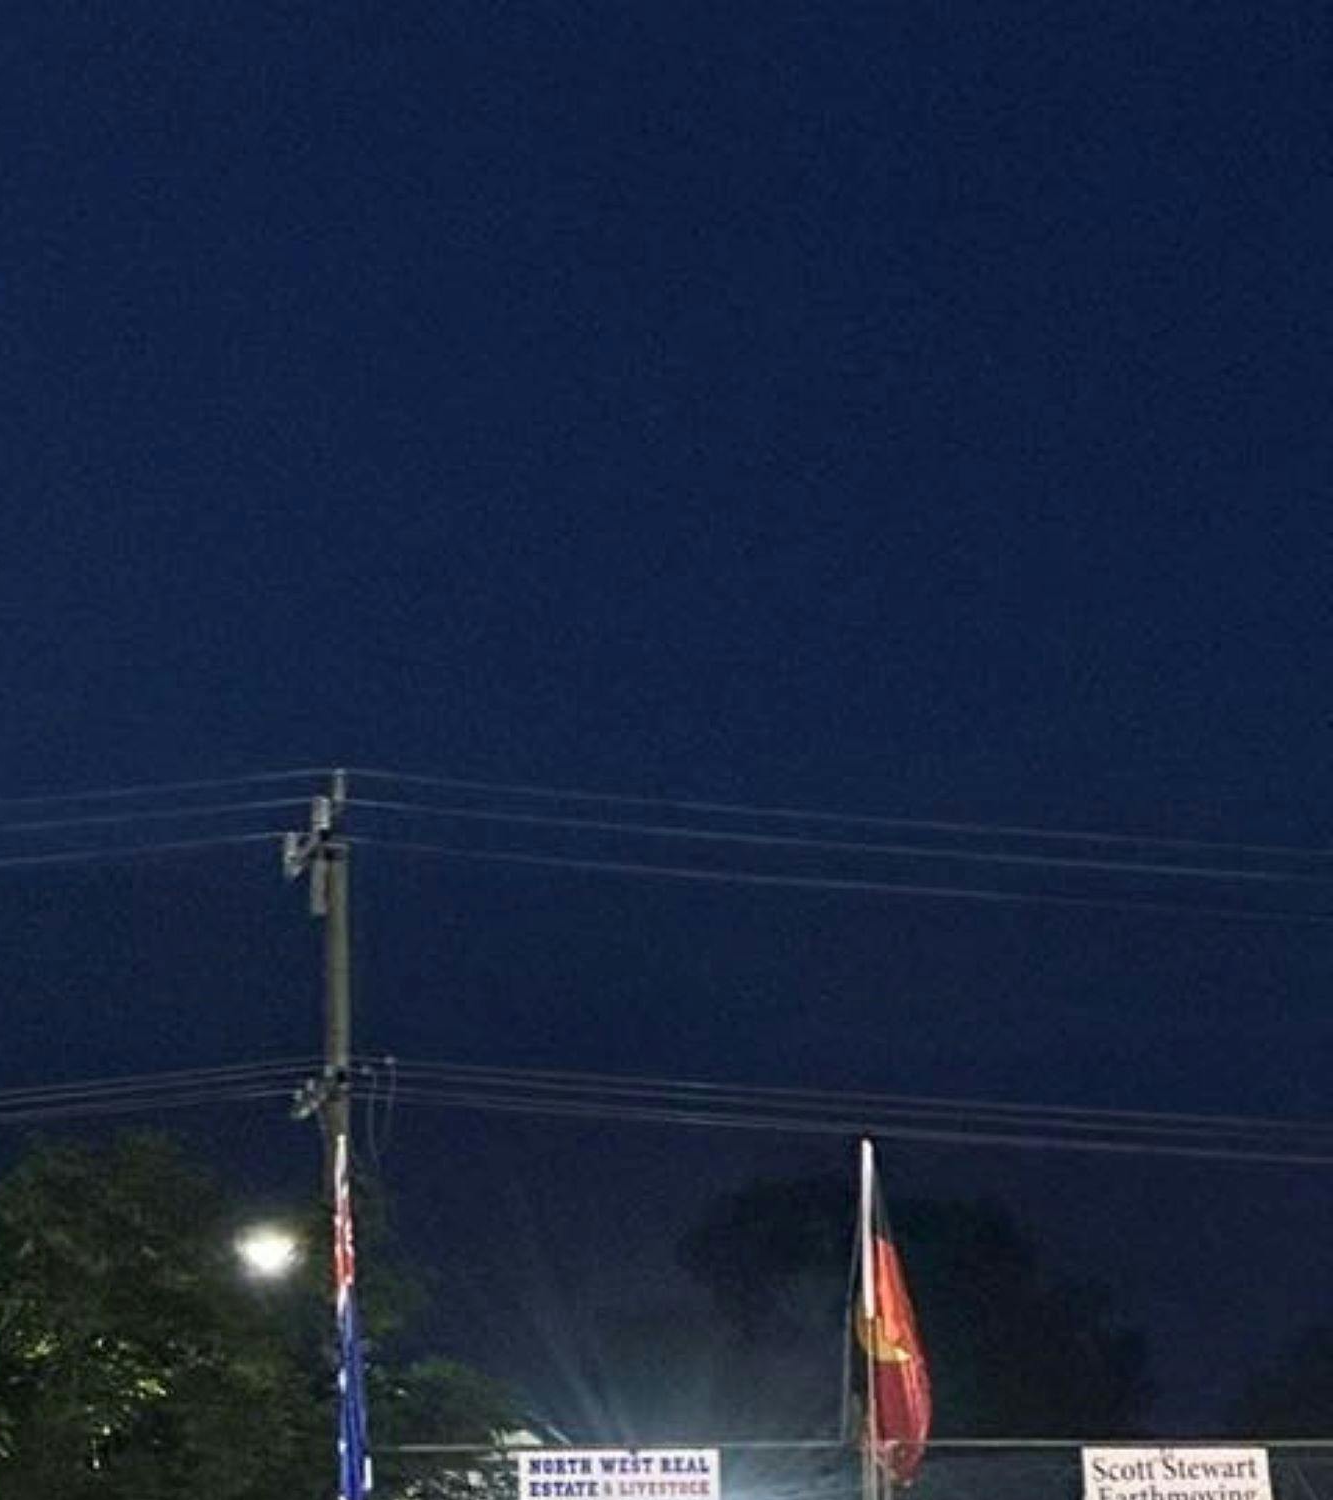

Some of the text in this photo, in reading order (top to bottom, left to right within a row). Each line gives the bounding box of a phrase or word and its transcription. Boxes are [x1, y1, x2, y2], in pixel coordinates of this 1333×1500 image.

[529, 1457, 710, 1475] NORTH WEST REAL
[1092, 1456, 1257, 1483] Scott Stewart
[529, 1482, 599, 1497] ESTATE
[620, 1482, 710, 1495] LIVESTOCK
